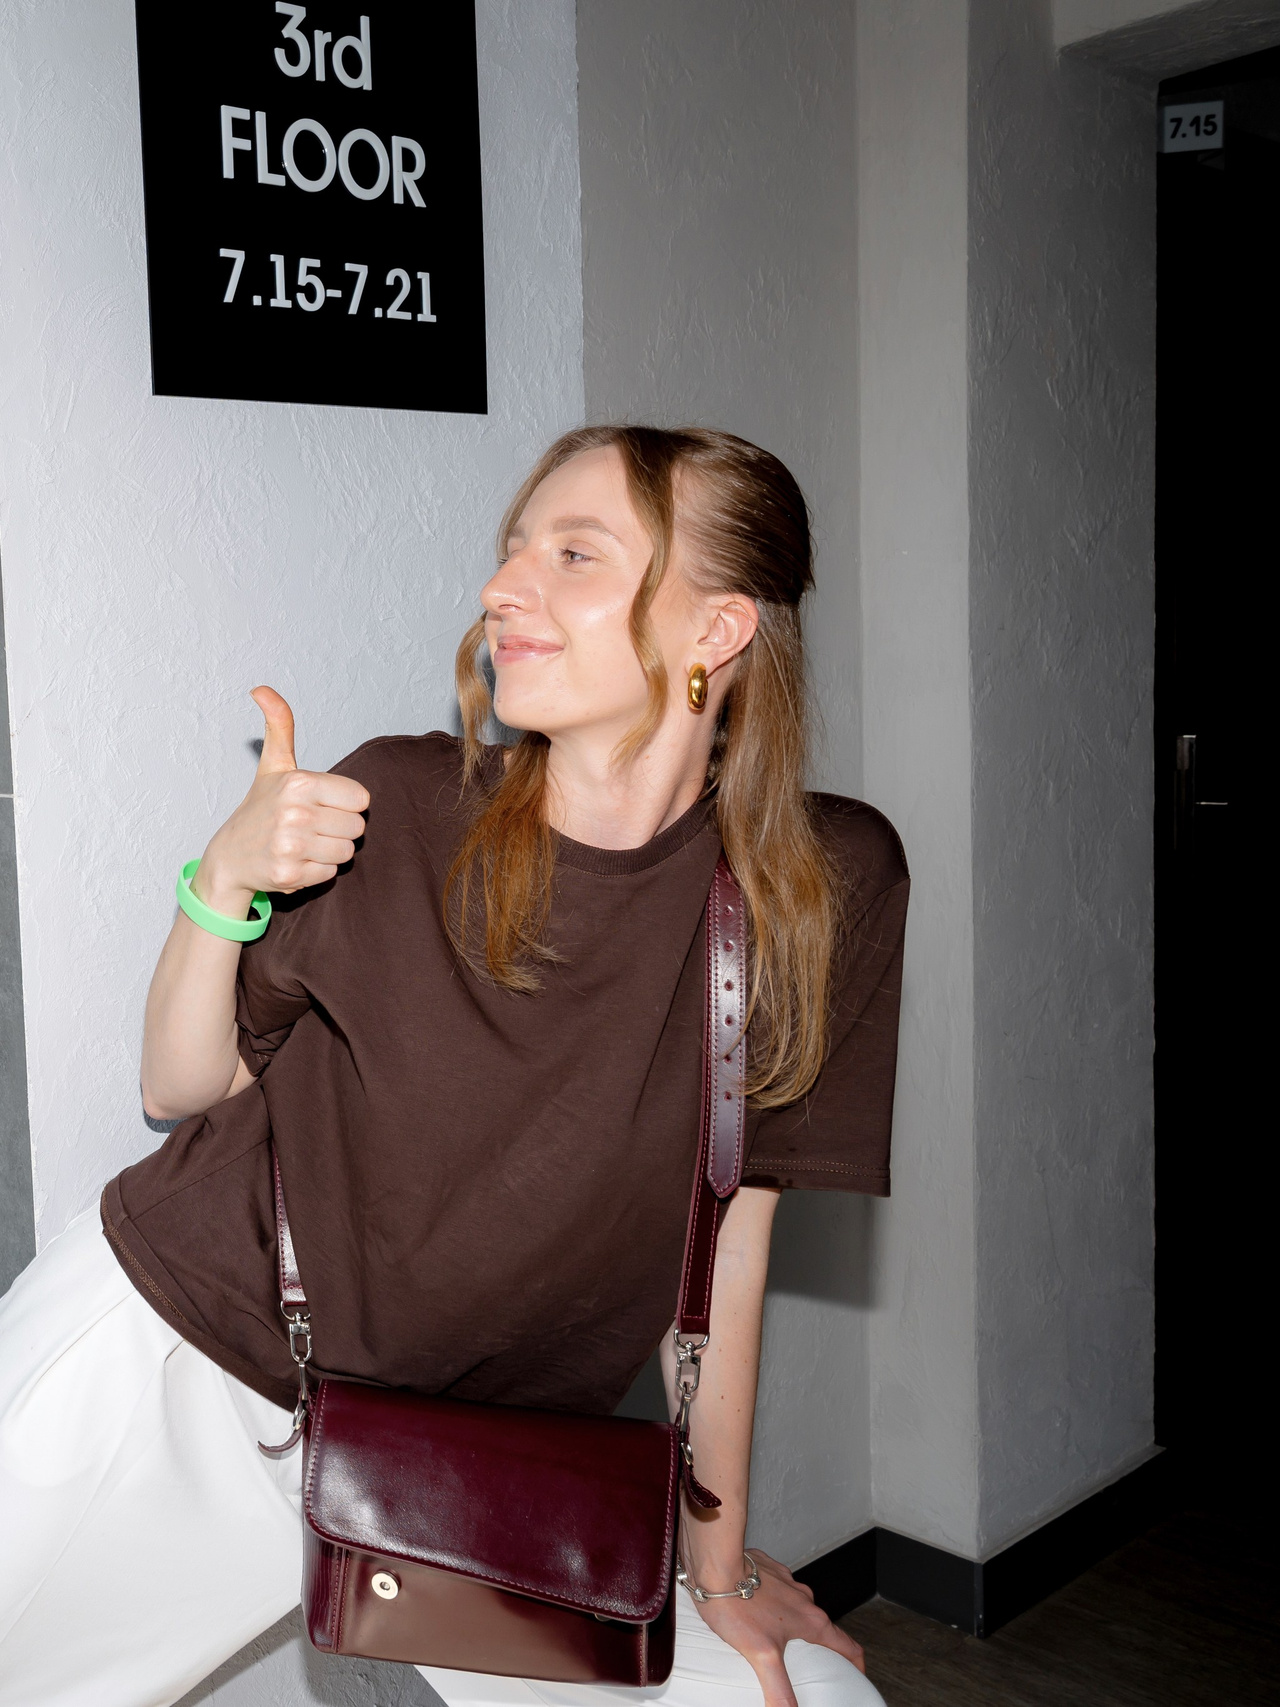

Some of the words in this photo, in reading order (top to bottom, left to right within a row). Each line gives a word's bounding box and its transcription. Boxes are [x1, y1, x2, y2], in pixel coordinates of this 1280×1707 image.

[274, 1, 373, 91] 3rd
[220, 104, 427, 208] FLOOR
[1169, 114, 1218, 139] 7.15
[219, 247, 437, 323] 7.15-7.21
